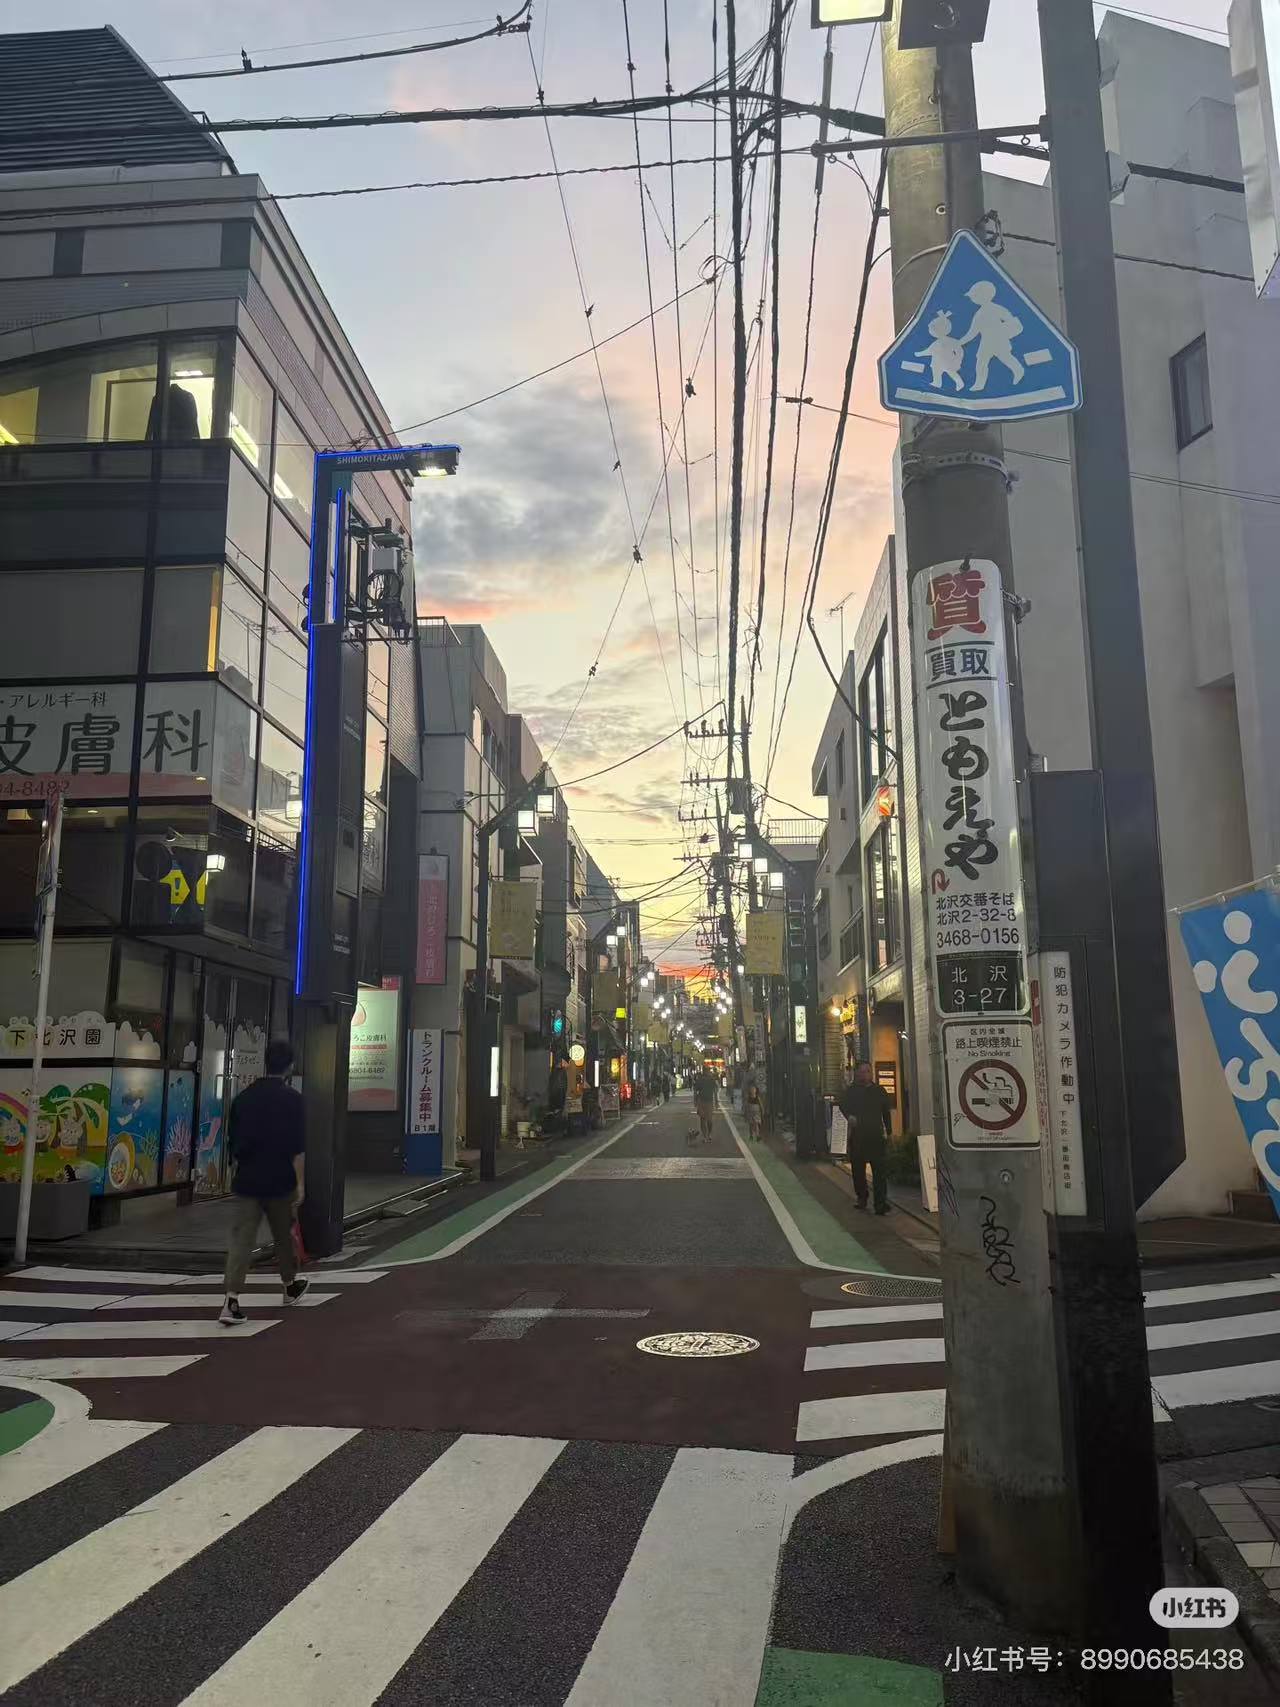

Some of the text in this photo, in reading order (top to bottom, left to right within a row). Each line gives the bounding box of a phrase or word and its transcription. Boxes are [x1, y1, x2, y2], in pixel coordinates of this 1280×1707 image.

[337, 453, 405, 464] SHIMOKITAZAWA
[926, 570, 986, 641] 質
[931, 649, 989, 681] 買取
[0, 708, 208, 776] 皮膚科
[936, 892, 1015, 911] 北沢交番そば
[937, 908, 1017, 925] 北沢2-32-8
[936, 928, 1020, 948] 3468-0156
[954, 987, 1008, 1005] 3-27
[956, 1037, 1022, 1049] 路上喫煙禁止
[1053, 966, 1075, 1105] 防犯カメラ作動中
[420, 1031, 433, 1122] トランクルーム募集中
